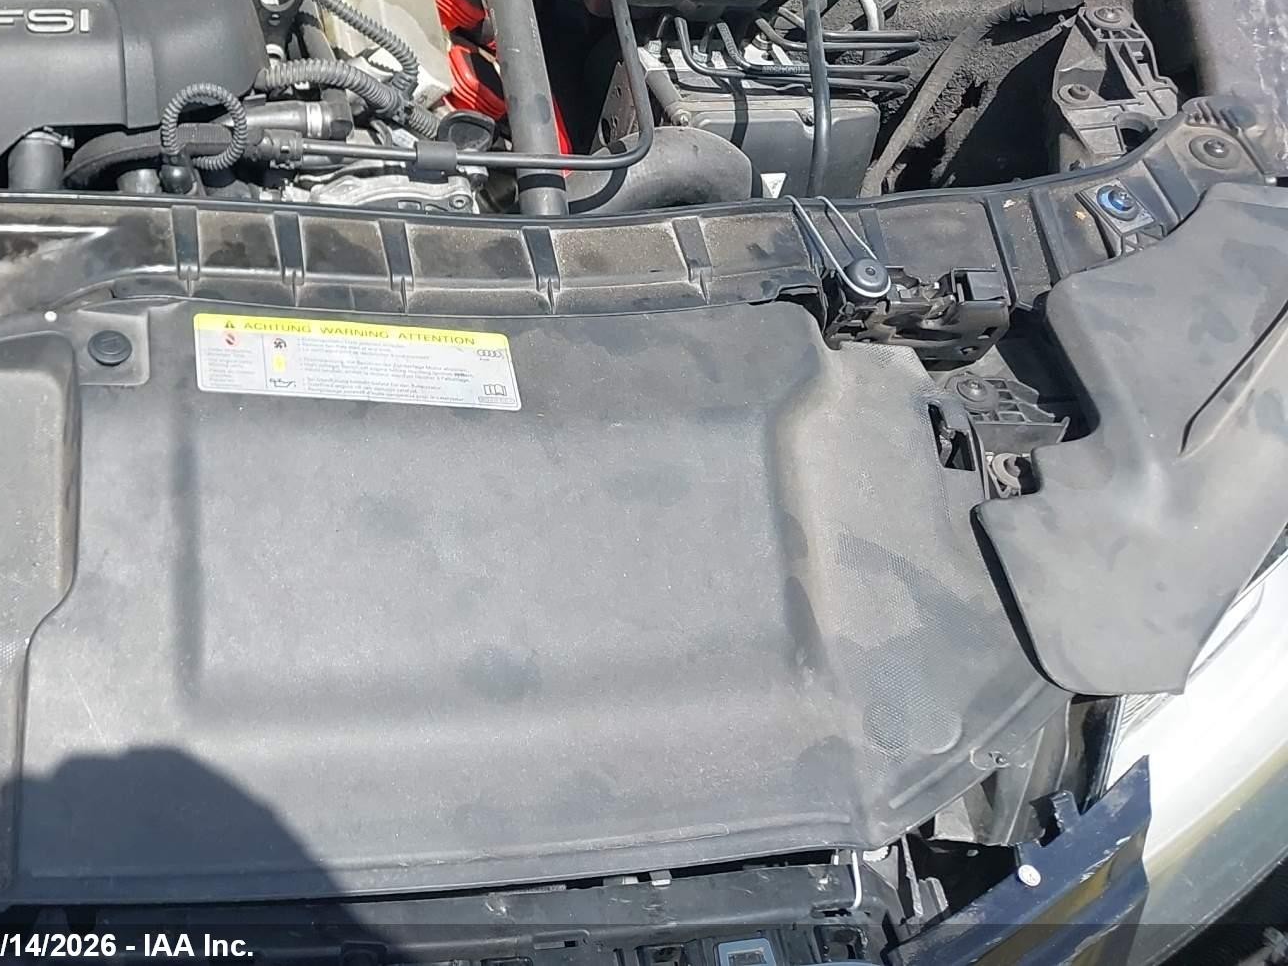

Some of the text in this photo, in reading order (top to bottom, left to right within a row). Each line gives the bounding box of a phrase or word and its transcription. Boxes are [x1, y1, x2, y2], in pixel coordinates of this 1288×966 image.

[244, 321, 475, 345] ACHTUNG WARNING ATTENTION
